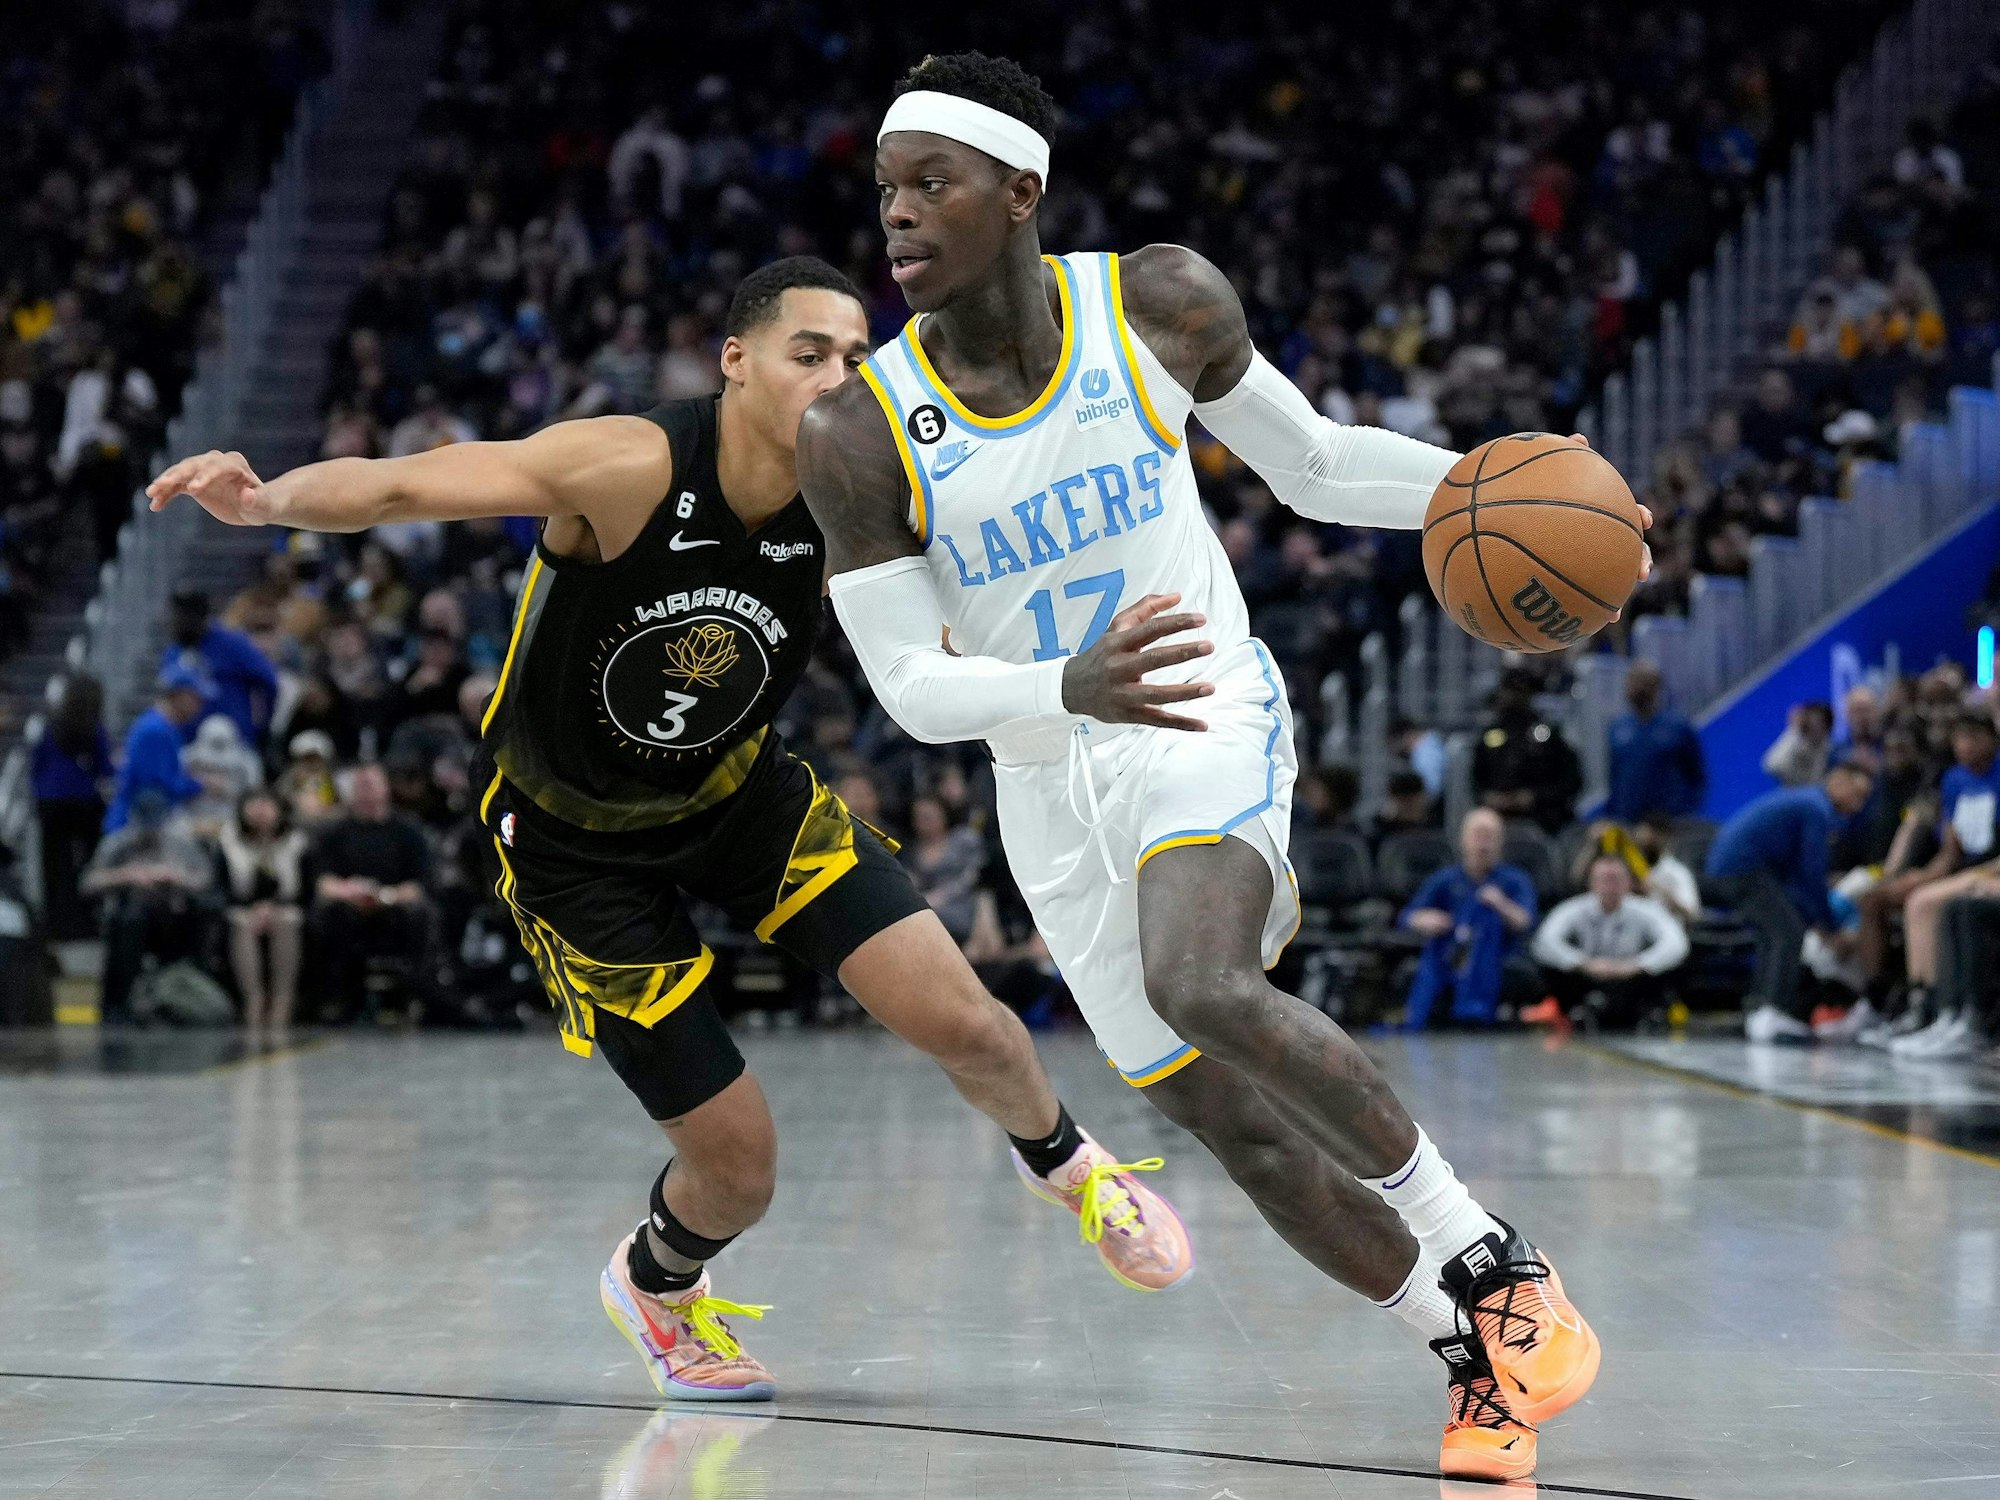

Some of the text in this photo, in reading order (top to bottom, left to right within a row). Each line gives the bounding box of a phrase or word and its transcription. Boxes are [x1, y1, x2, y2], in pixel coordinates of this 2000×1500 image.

[915, 408, 941, 441] 6
[1076, 397, 1129, 424] bibigo
[936, 440, 969, 467] NIKE
[676, 491, 696, 519] 6
[936, 450, 1165, 587] LAKERS
[760, 540, 814, 562] Rakuten
[635, 587, 788, 645] WARRIORS
[1024, 568, 1125, 662] 17
[1510, 575, 1590, 645] Wil
[647, 690, 699, 740] 3
